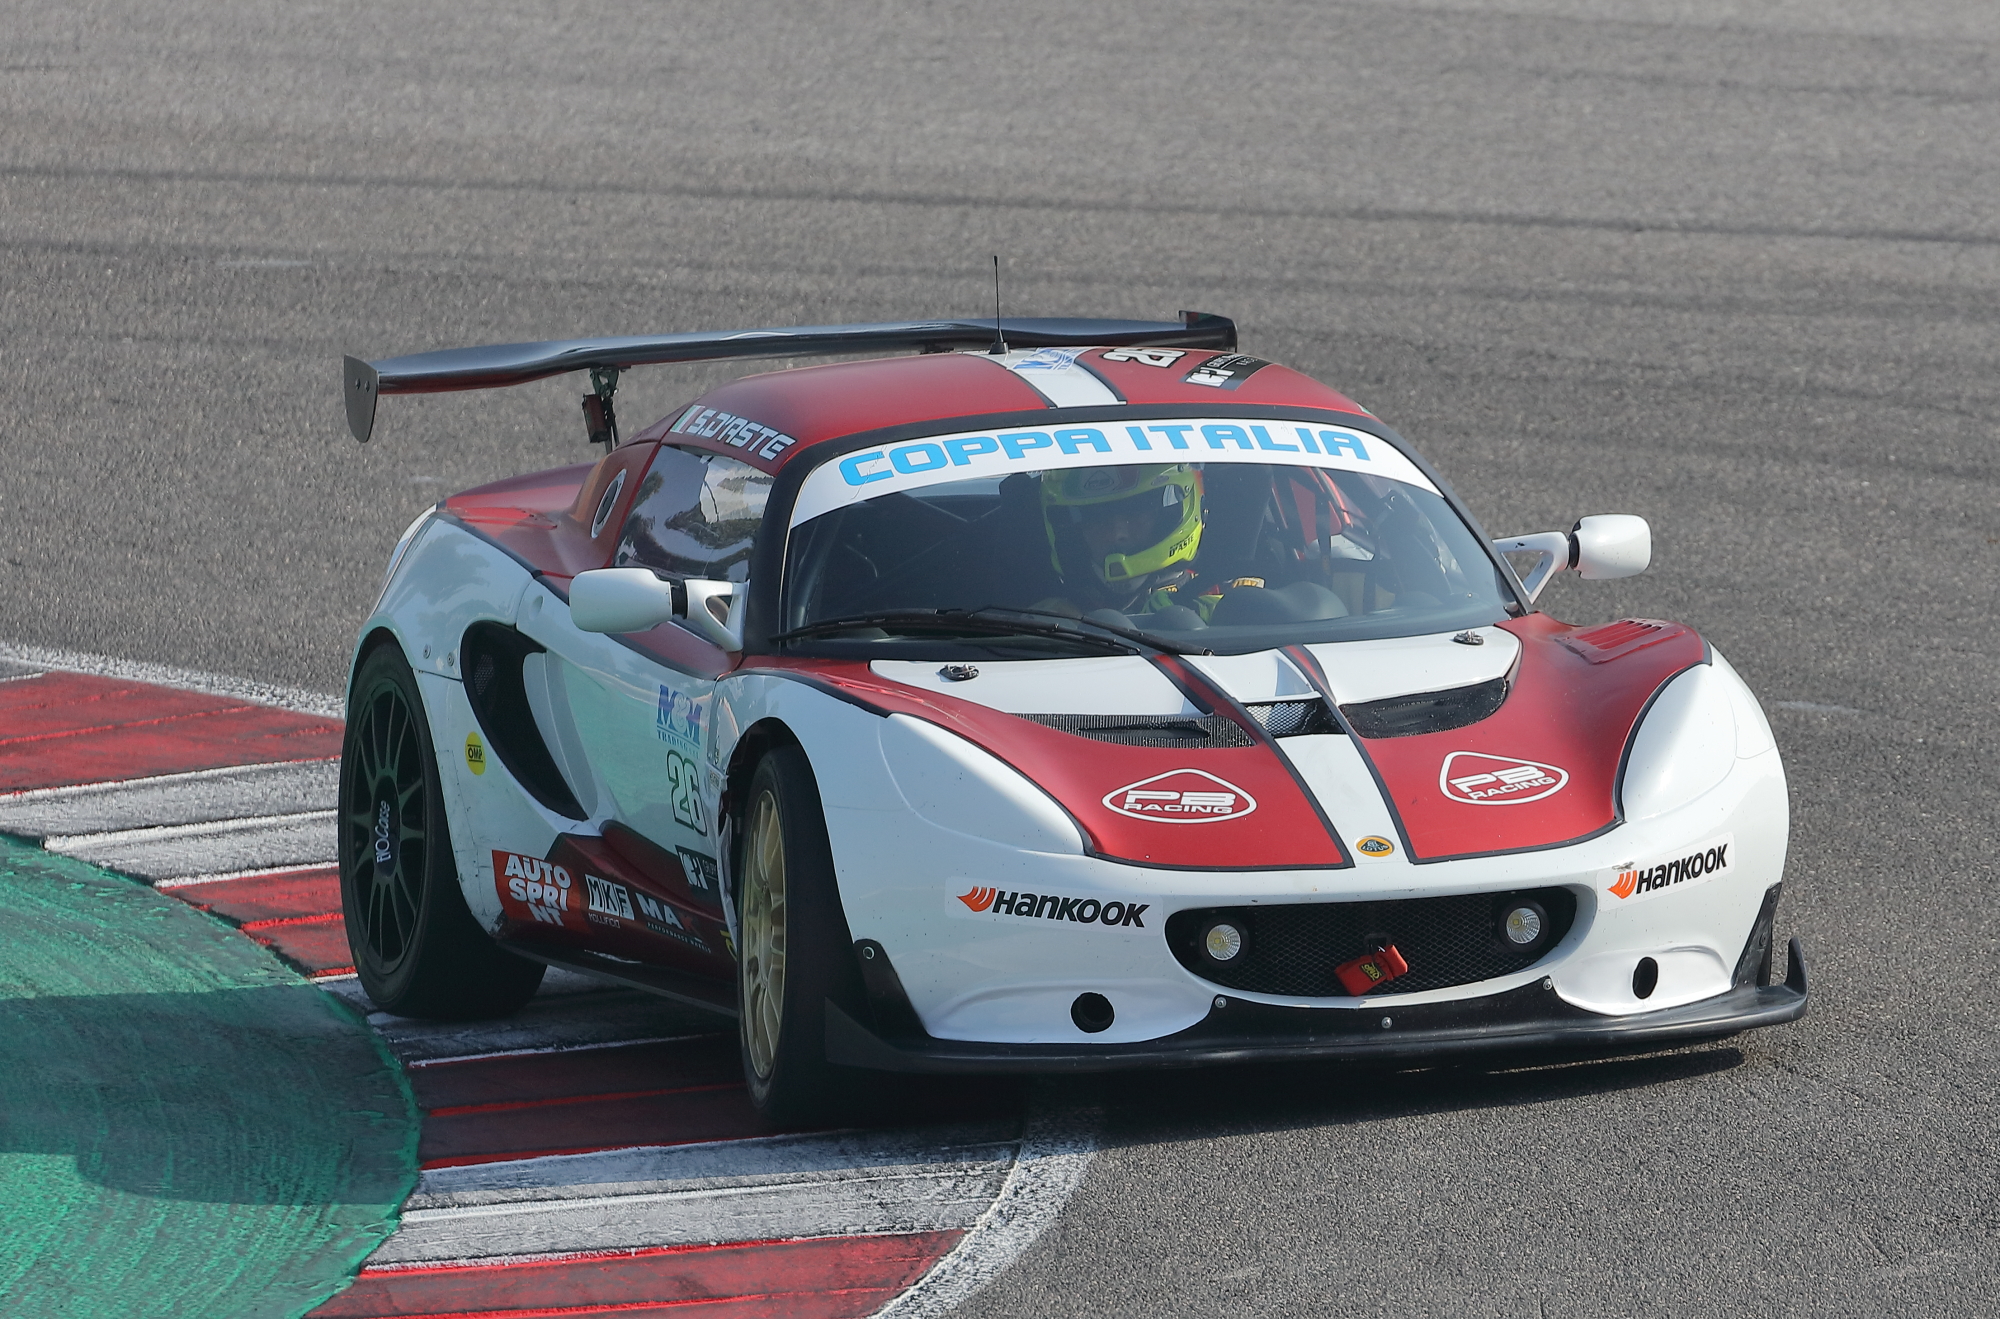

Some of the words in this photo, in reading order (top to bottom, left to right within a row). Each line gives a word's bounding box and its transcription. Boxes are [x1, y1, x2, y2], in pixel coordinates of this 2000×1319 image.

[838, 427, 1113, 487] COPPA
[1125, 424, 1371, 461] ITALIA
[657, 684, 702, 746] M&M
[467, 746, 483, 760] OMP
[667, 749, 707, 836] 26
[1448, 765, 1546, 793] PB
[1467, 776, 1557, 800] RACING
[1123, 803, 1234, 814] RACING
[1125, 790, 1236, 806] PB
[504, 854, 571, 889] AUTO
[508, 878, 568, 912] SPRI
[528, 903, 564, 927] NT
